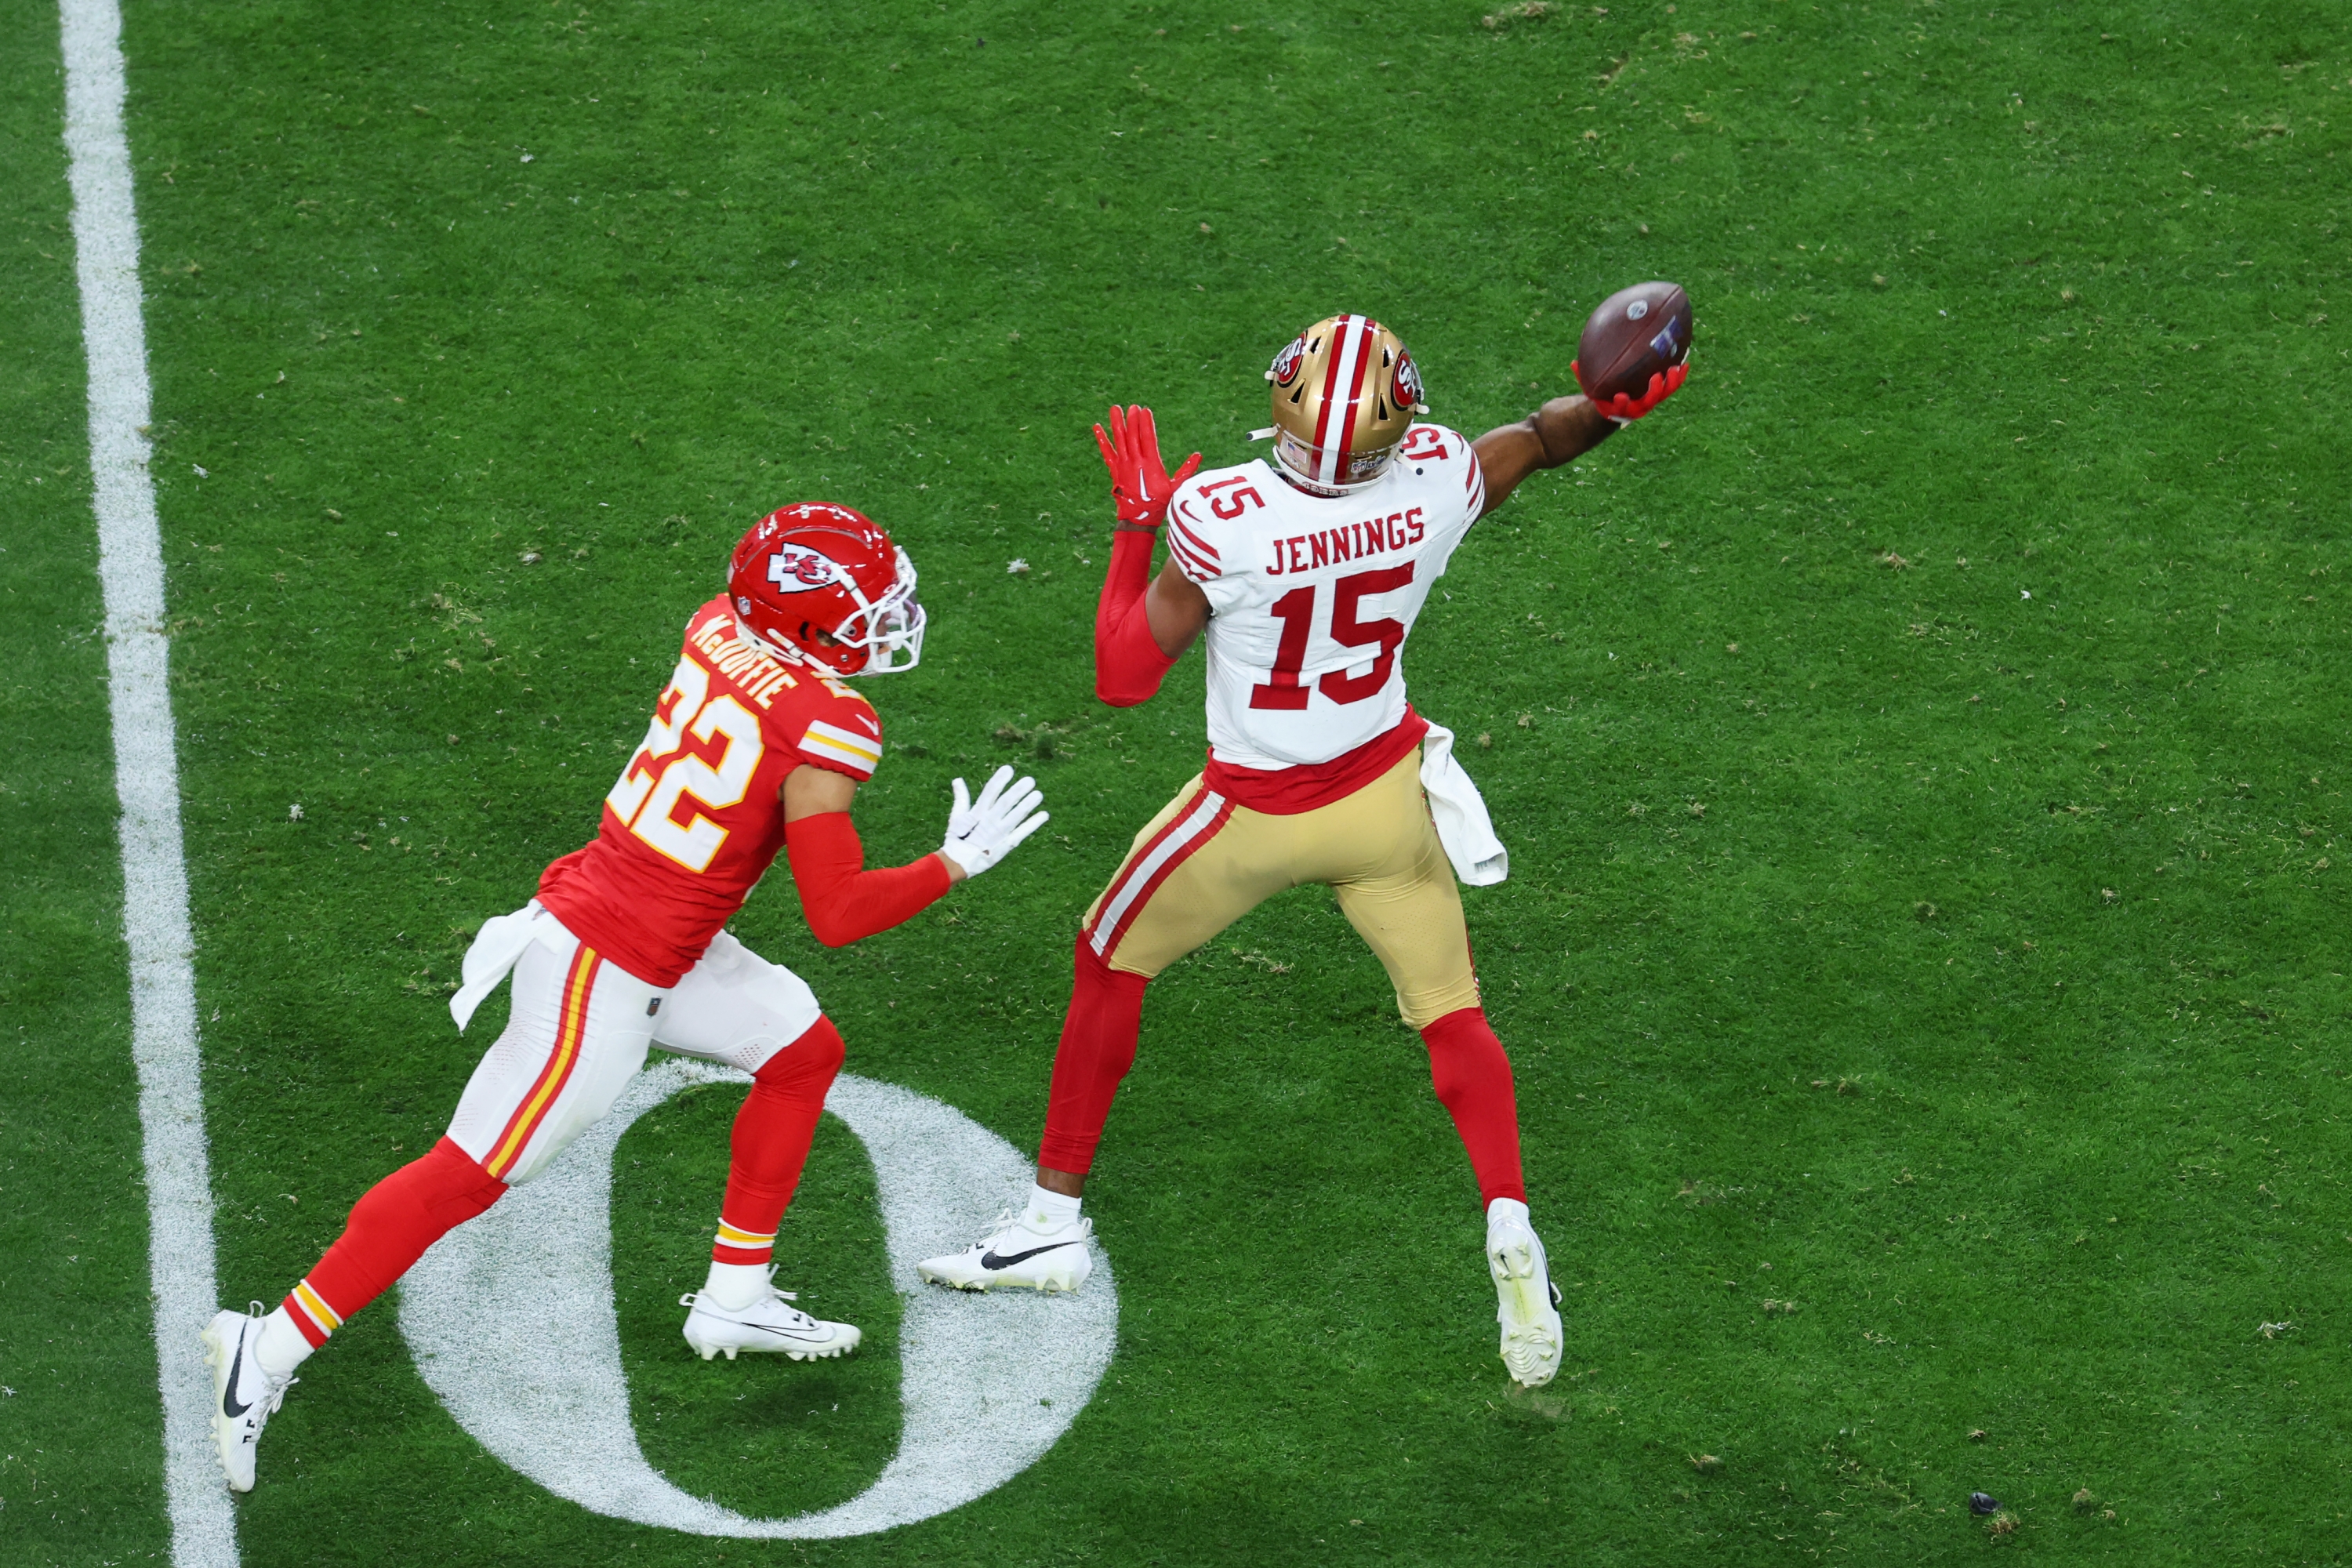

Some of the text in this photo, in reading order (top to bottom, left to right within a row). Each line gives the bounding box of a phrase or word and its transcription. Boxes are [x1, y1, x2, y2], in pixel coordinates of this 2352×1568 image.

[1197, 476, 1265, 520] 15
[1402, 427, 1449, 460] 15
[1266, 507, 1425, 575] JENNINGS
[1249, 560, 1415, 710] 15
[605, 653, 764, 873] 22
[397, 1058, 1118, 1541] 0
